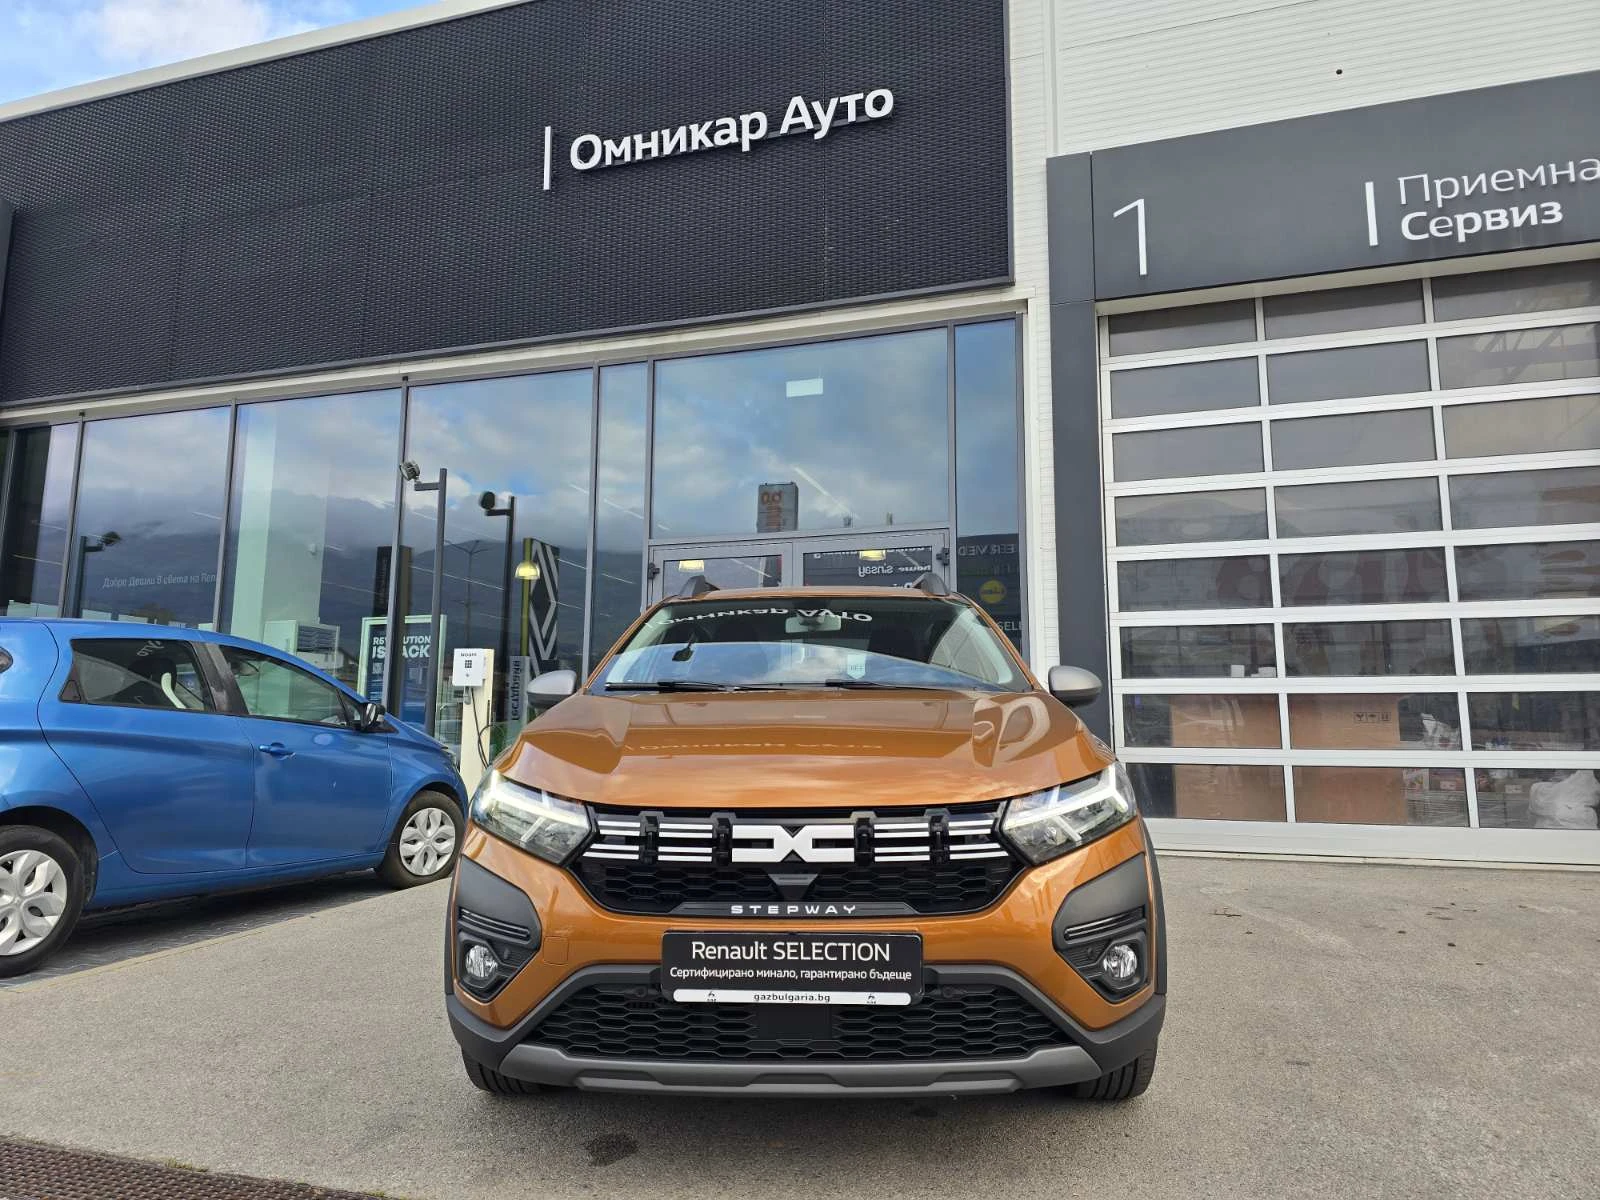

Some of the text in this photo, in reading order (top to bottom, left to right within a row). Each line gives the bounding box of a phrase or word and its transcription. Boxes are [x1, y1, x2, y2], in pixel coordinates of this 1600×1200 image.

[570, 88, 894, 171] Омникар Ауто
[1397, 158, 1600, 208] Приемна
[1401, 201, 1563, 242] Сервиз
[1113, 199, 1148, 275] 1
[401, 645, 430, 658] ACK
[730, 905, 856, 915] STEPWAY
[691, 941, 890, 962] Renault SELECTION
[669, 967, 912, 981] Сертифицирано минало, гарантирано бъдеще
[753, 993, 831, 1003] gazbulgaria.bg
